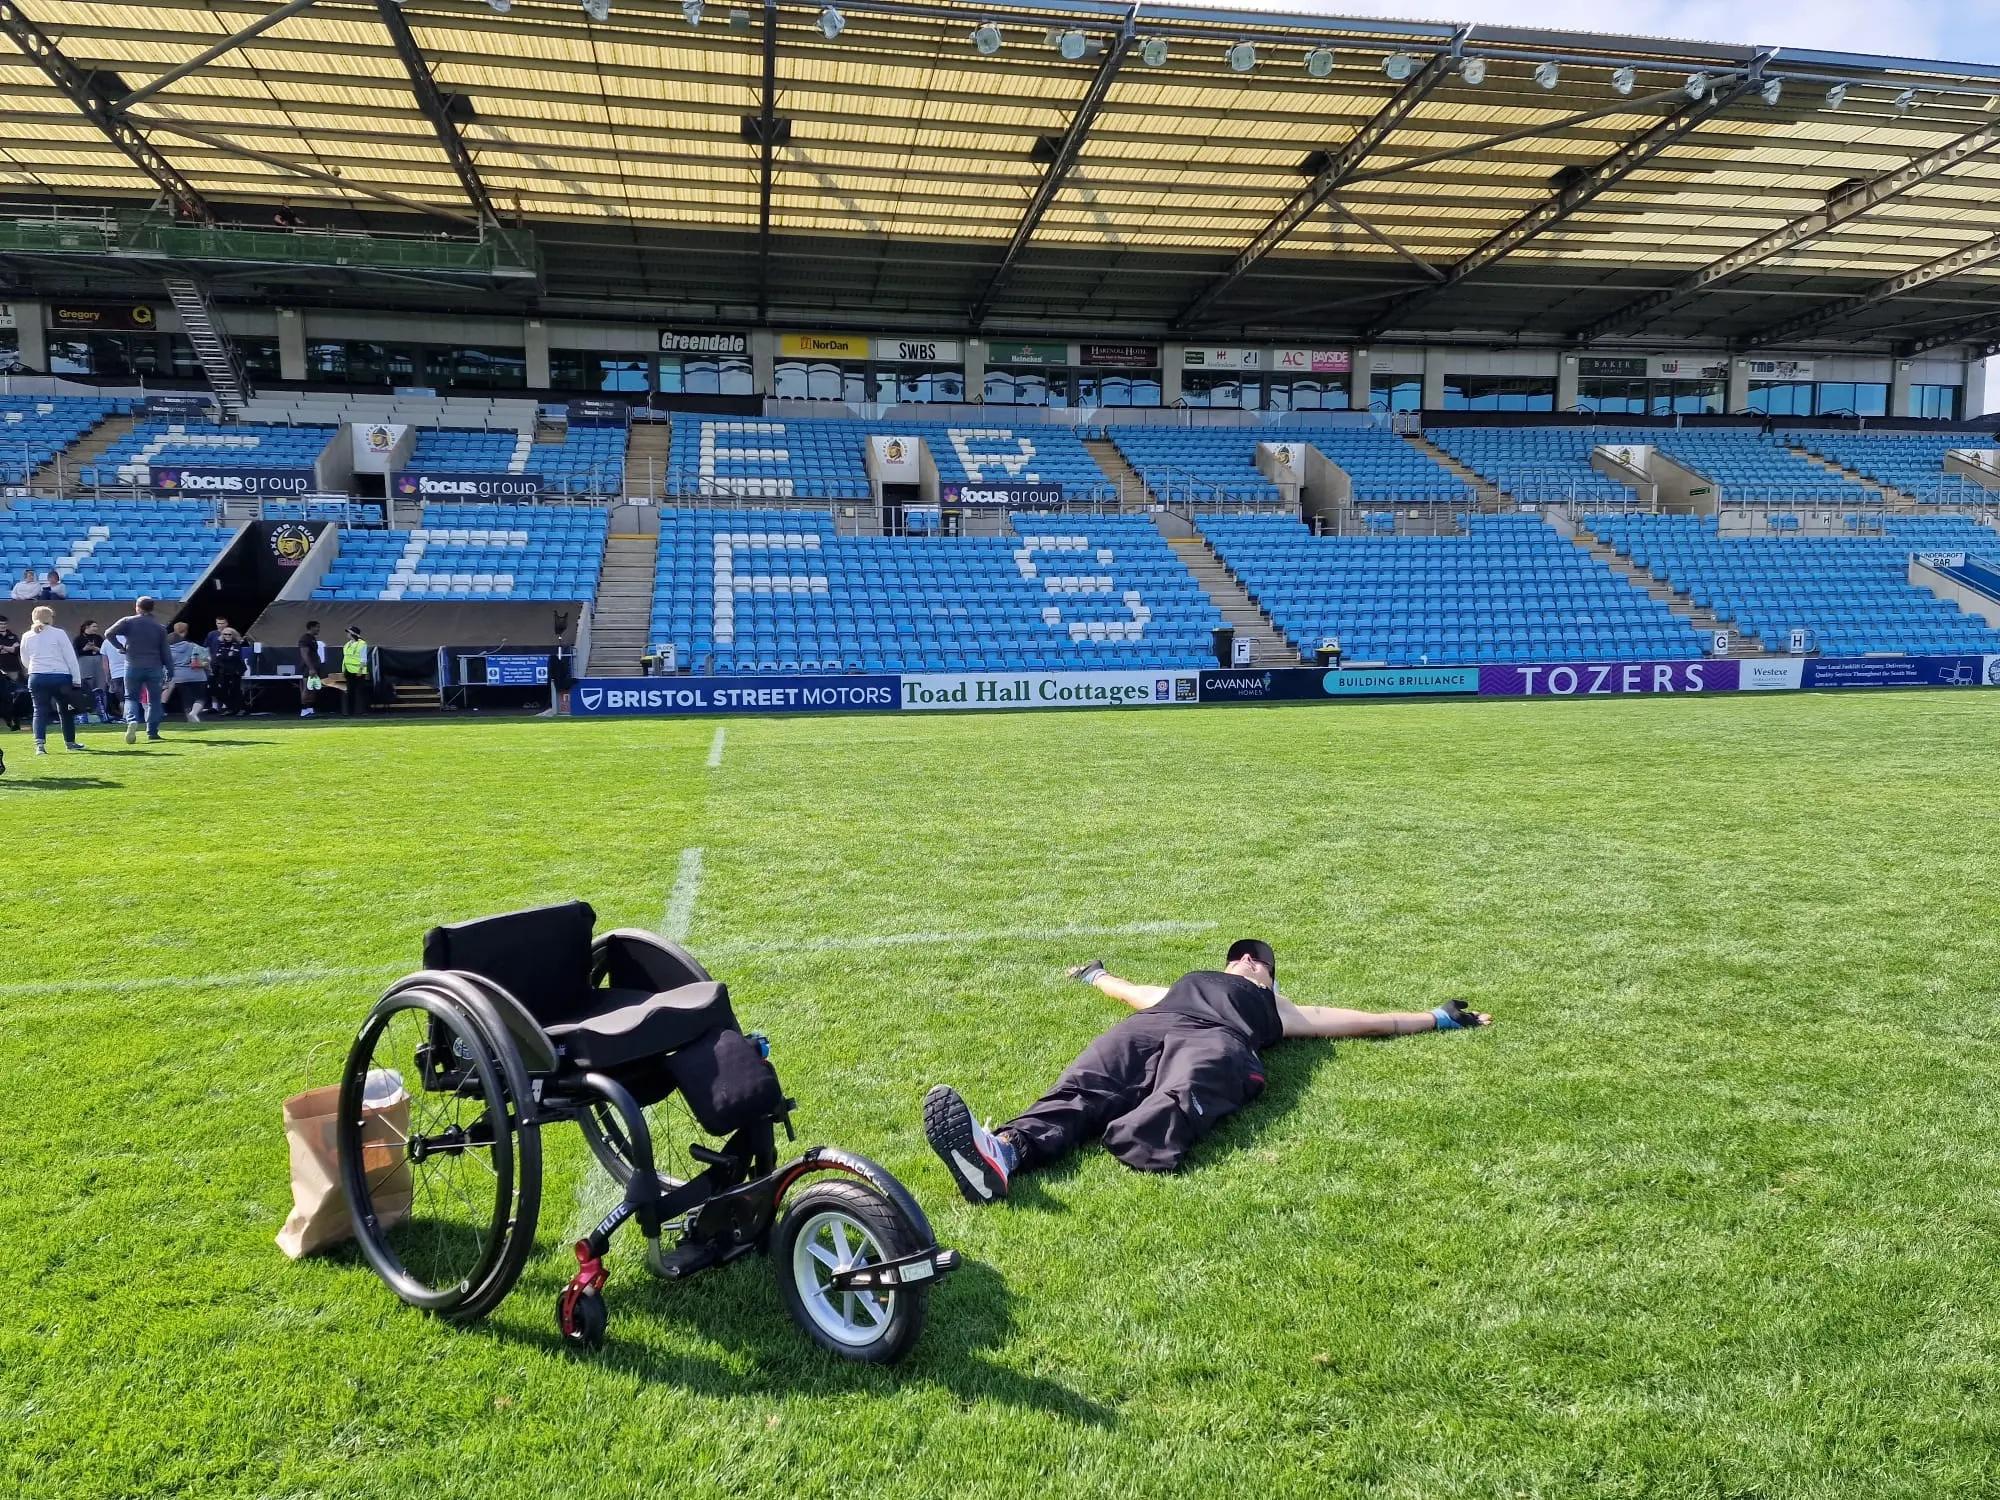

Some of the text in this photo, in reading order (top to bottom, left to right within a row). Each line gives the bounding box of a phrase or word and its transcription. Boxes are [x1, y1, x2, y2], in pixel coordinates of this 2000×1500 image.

[59, 309, 101, 320] Gregory
[661, 331, 745, 352] Greendale
[812, 339, 849, 351] NorDan
[899, 342, 936, 360] SWBS
[1312, 351, 1349, 363] BAYSIDE
[1282, 351, 1305, 366] AC
[1594, 360, 1631, 368] BAKER
[180, 471, 308, 494] focus group
[419, 476, 537, 497] focus group
[960, 486, 1060, 506] focus group
[1716, 637, 1727, 648] G
[1793, 635, 1802, 647] H
[1237, 644, 1247, 656] F
[1754, 668, 1788, 676] Westexe
[1205, 677, 1263, 690] CAVANNA
[1339, 675, 1465, 687] BUILDING BRILLIANCE
[1516, 664, 1705, 696] TOZERS
[607, 686, 892, 708] BRISTOL STREET MOTORS
[902, 681, 967, 704] Toad
[975, 680, 1031, 702] Hall
[1038, 679, 1149, 705] Cottages
[596, 1203, 629, 1235] TILITE
